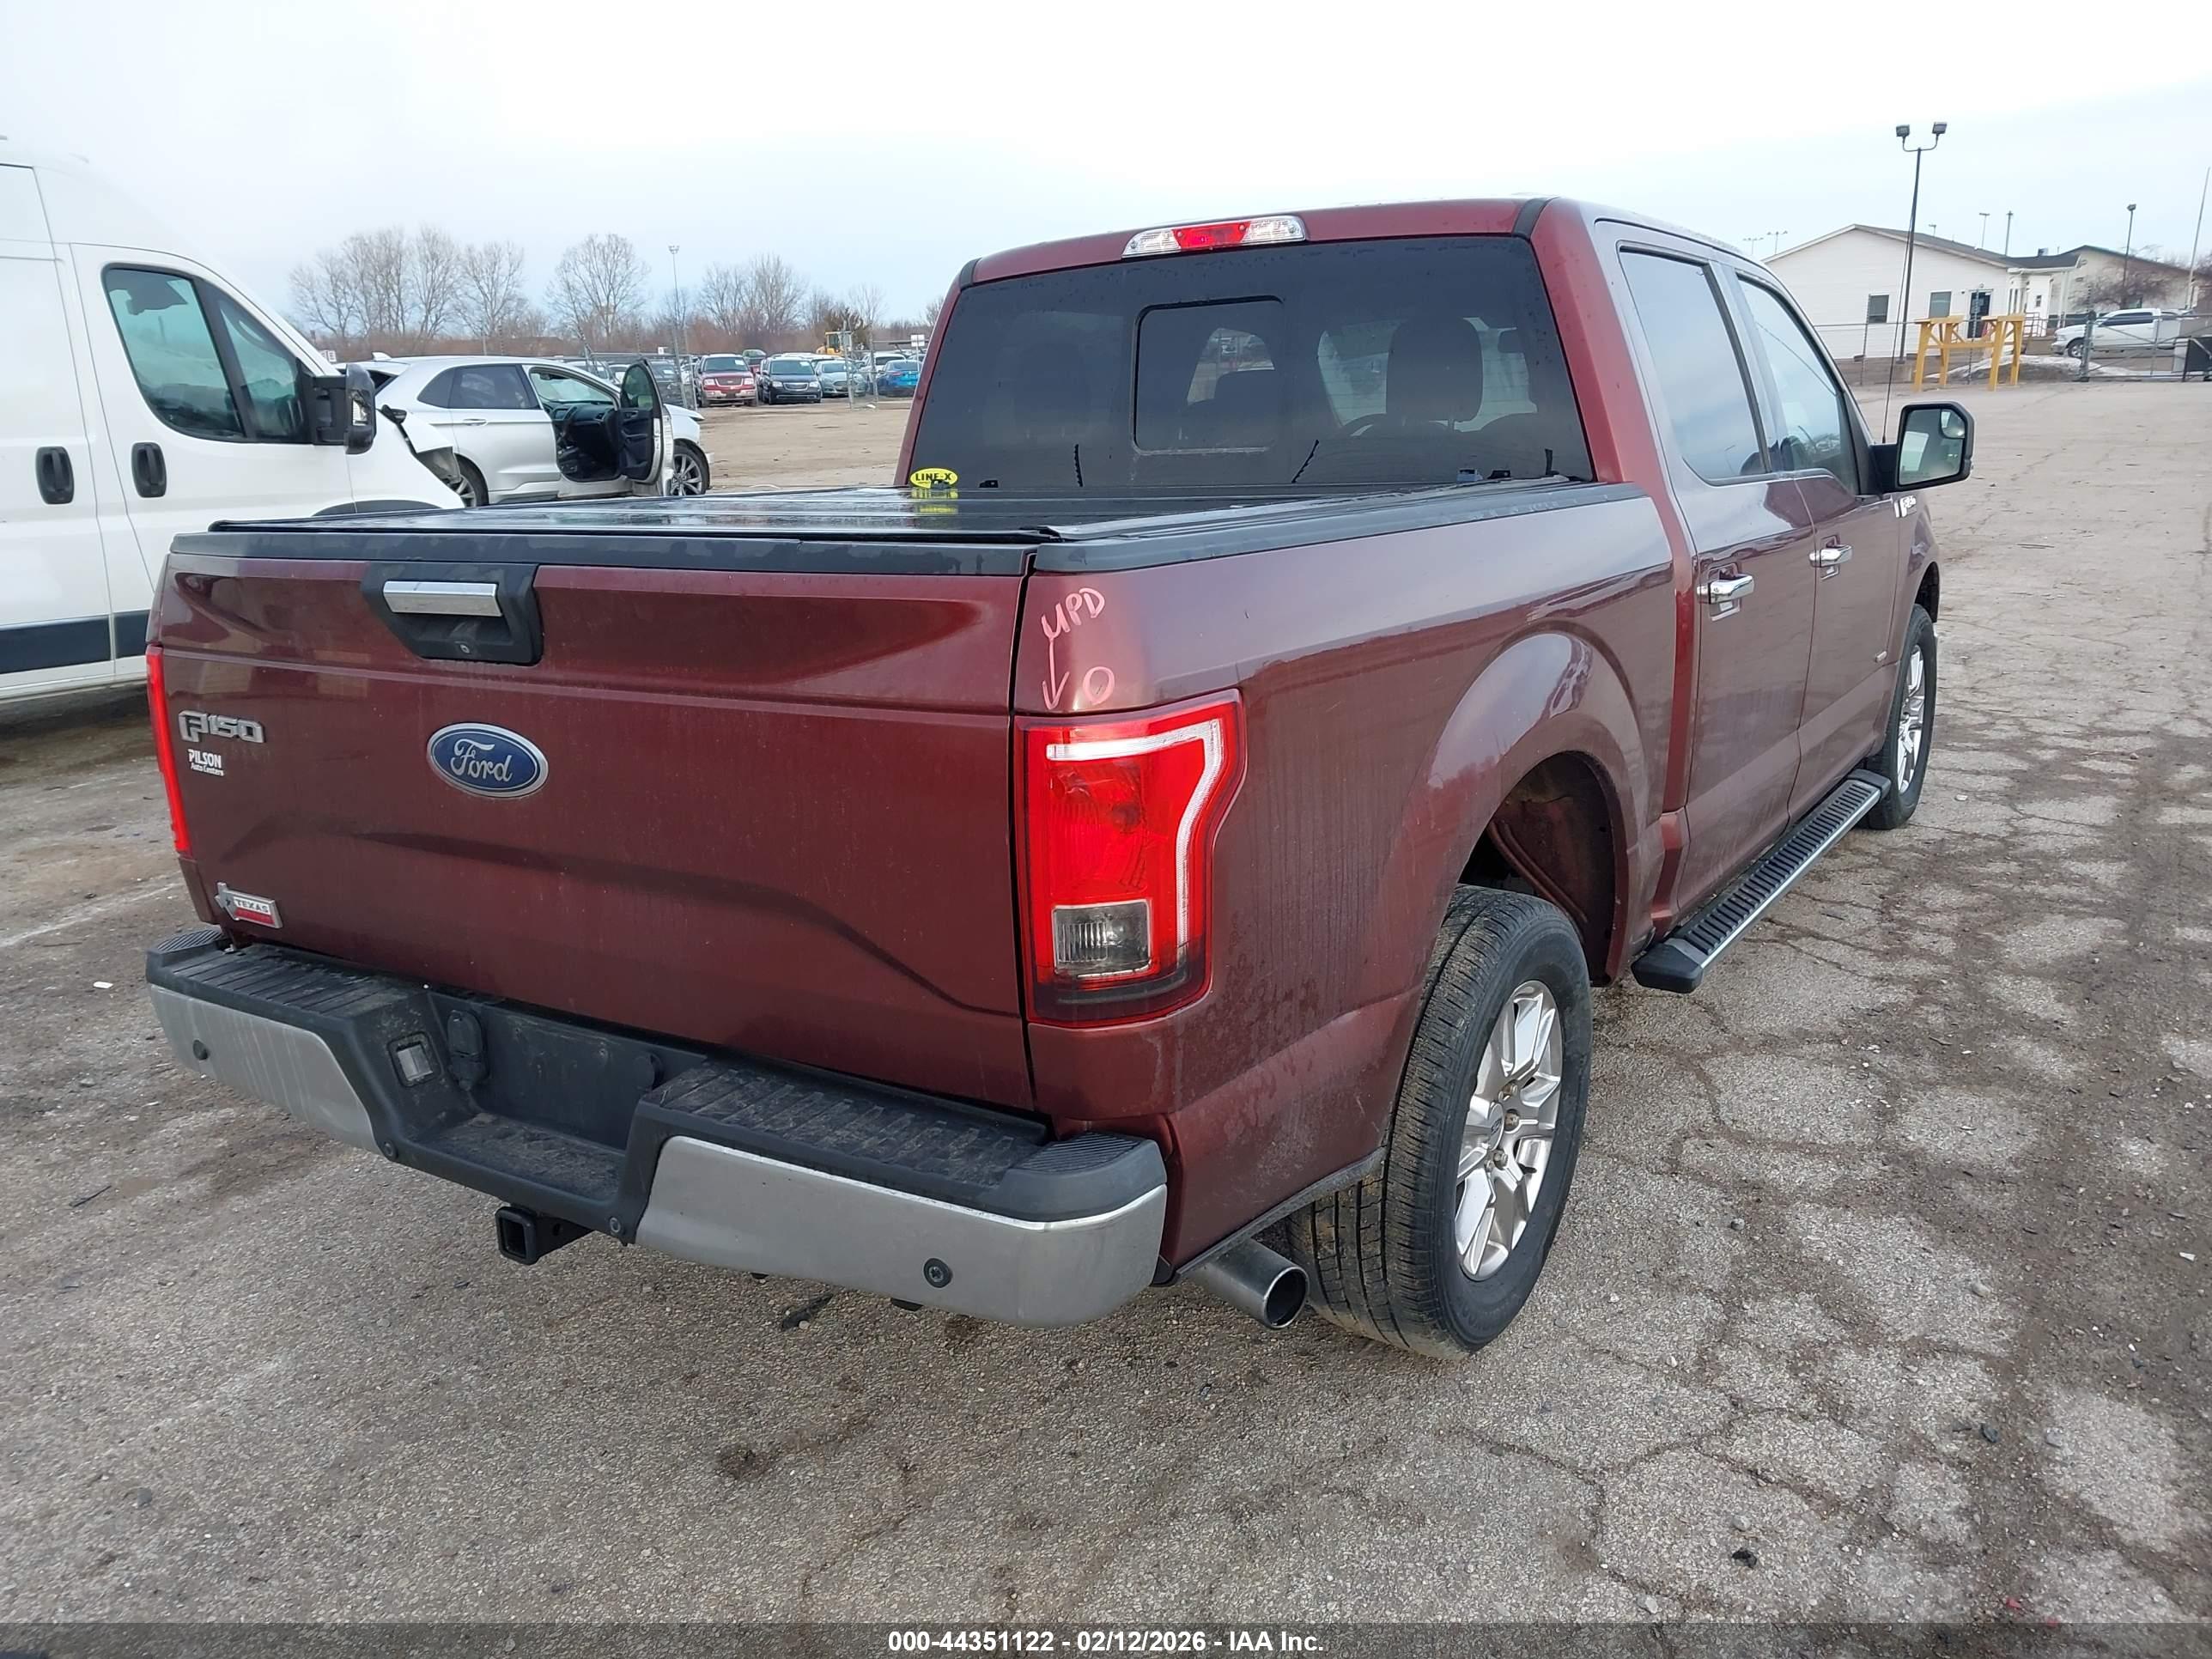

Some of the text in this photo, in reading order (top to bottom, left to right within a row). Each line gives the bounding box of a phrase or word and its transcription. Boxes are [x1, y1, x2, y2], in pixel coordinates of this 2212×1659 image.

[915, 472, 952, 482] LINE-X
[188, 749, 222, 769] PILSON
[450, 738, 514, 781] Ford
[235, 898, 269, 913] TEXAS
